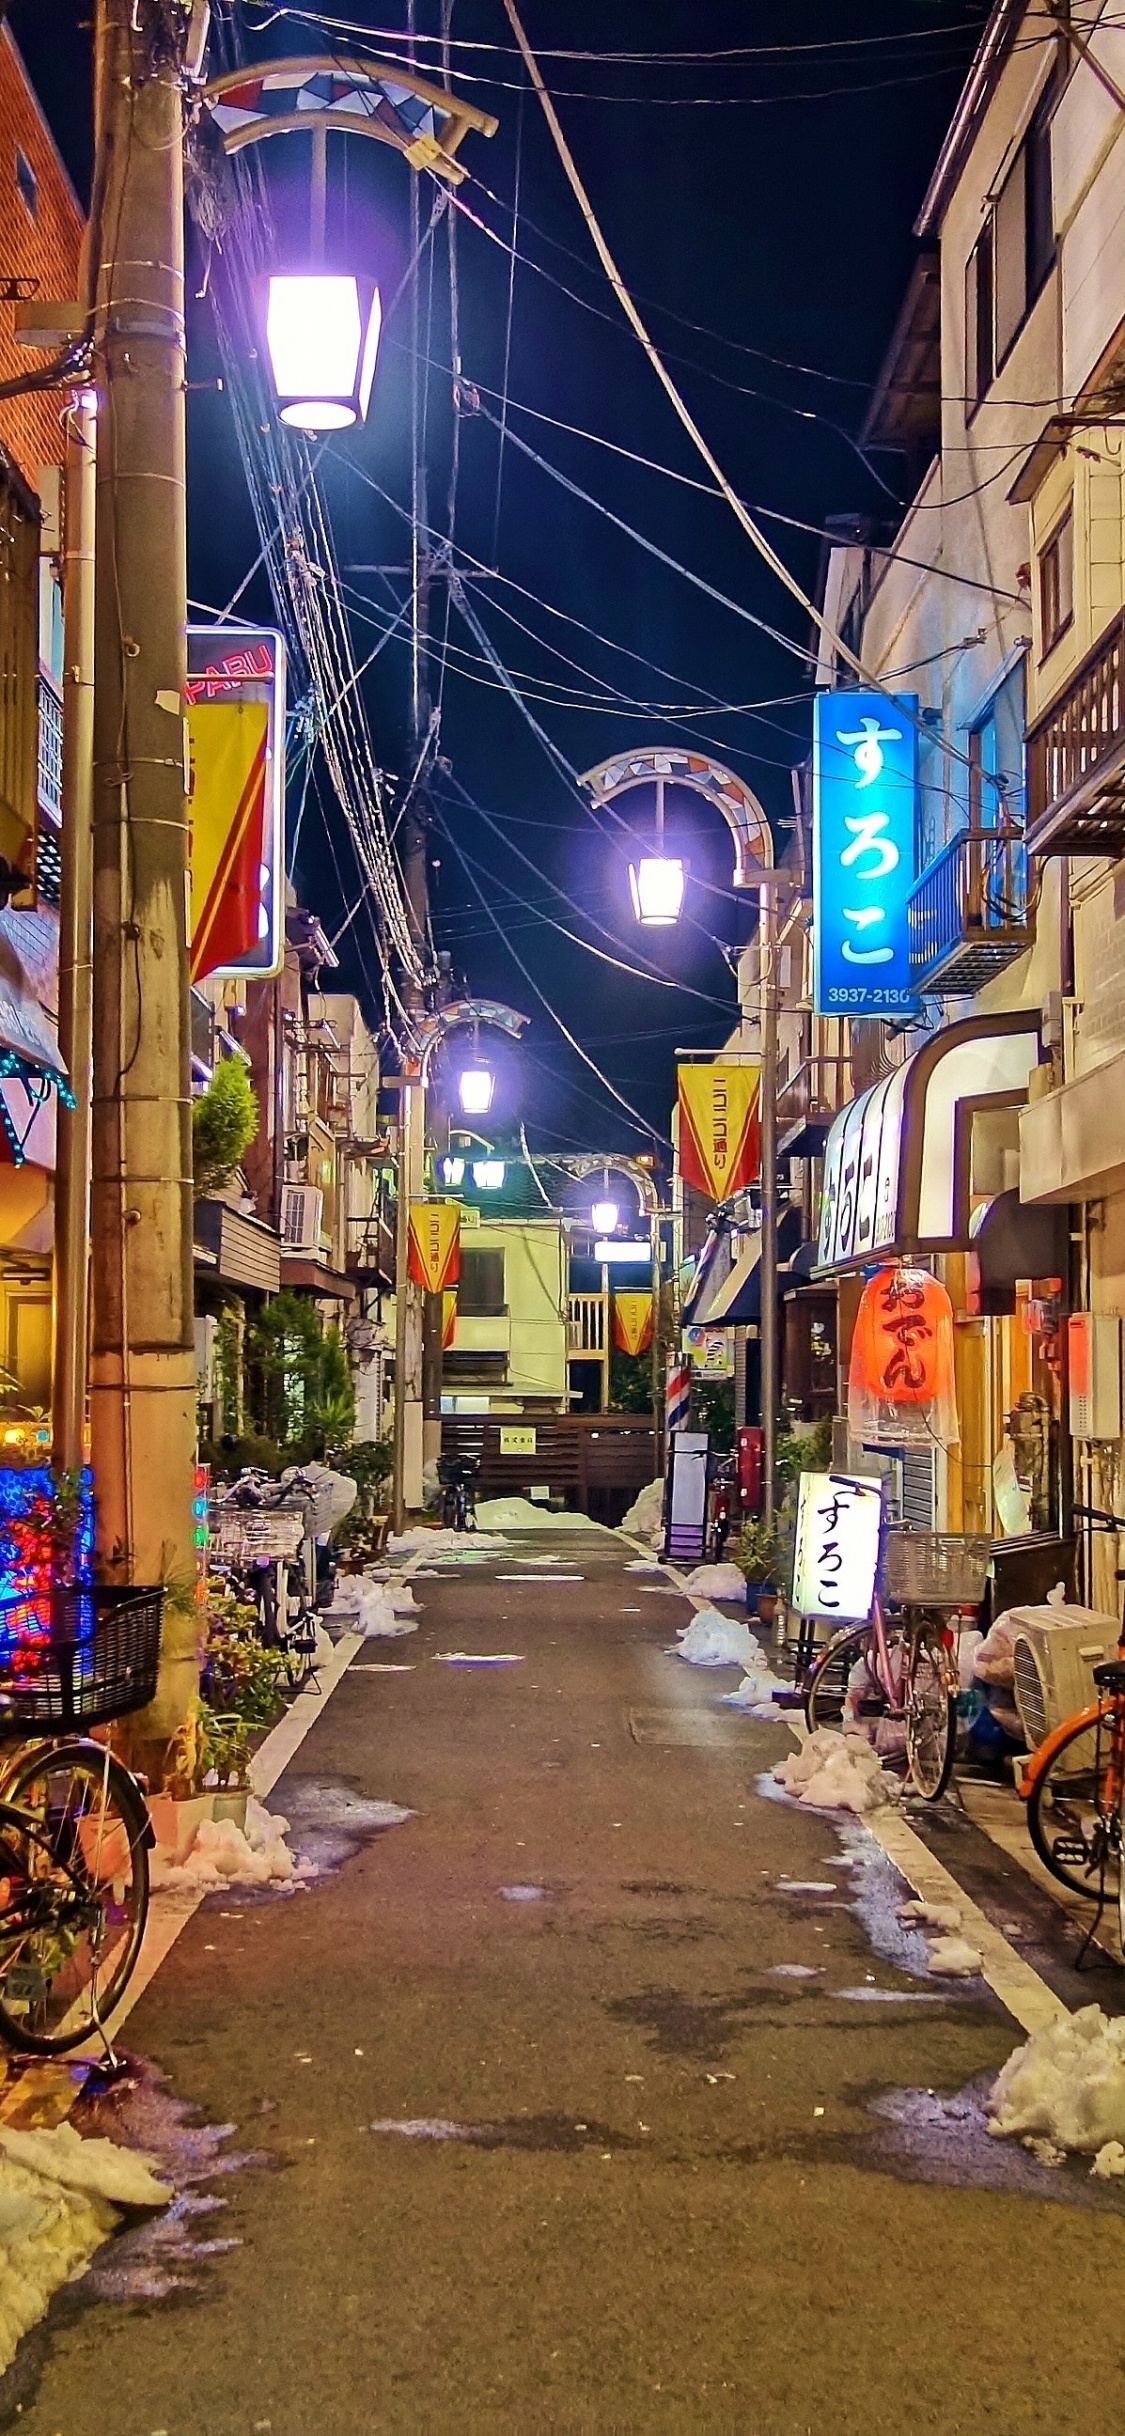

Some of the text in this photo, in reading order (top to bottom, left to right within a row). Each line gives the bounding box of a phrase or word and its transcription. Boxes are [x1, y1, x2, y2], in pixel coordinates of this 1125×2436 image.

[836, 717, 903, 965] すろこ
[828, 987, 911, 1004] 3937-2130
[713, 1077, 729, 1170] ニコニコ通り
[430, 1213, 440, 1273] ニコニコ通り
[880, 1279, 932, 1389] おでん
[817, 1495, 850, 1608] すろこ
